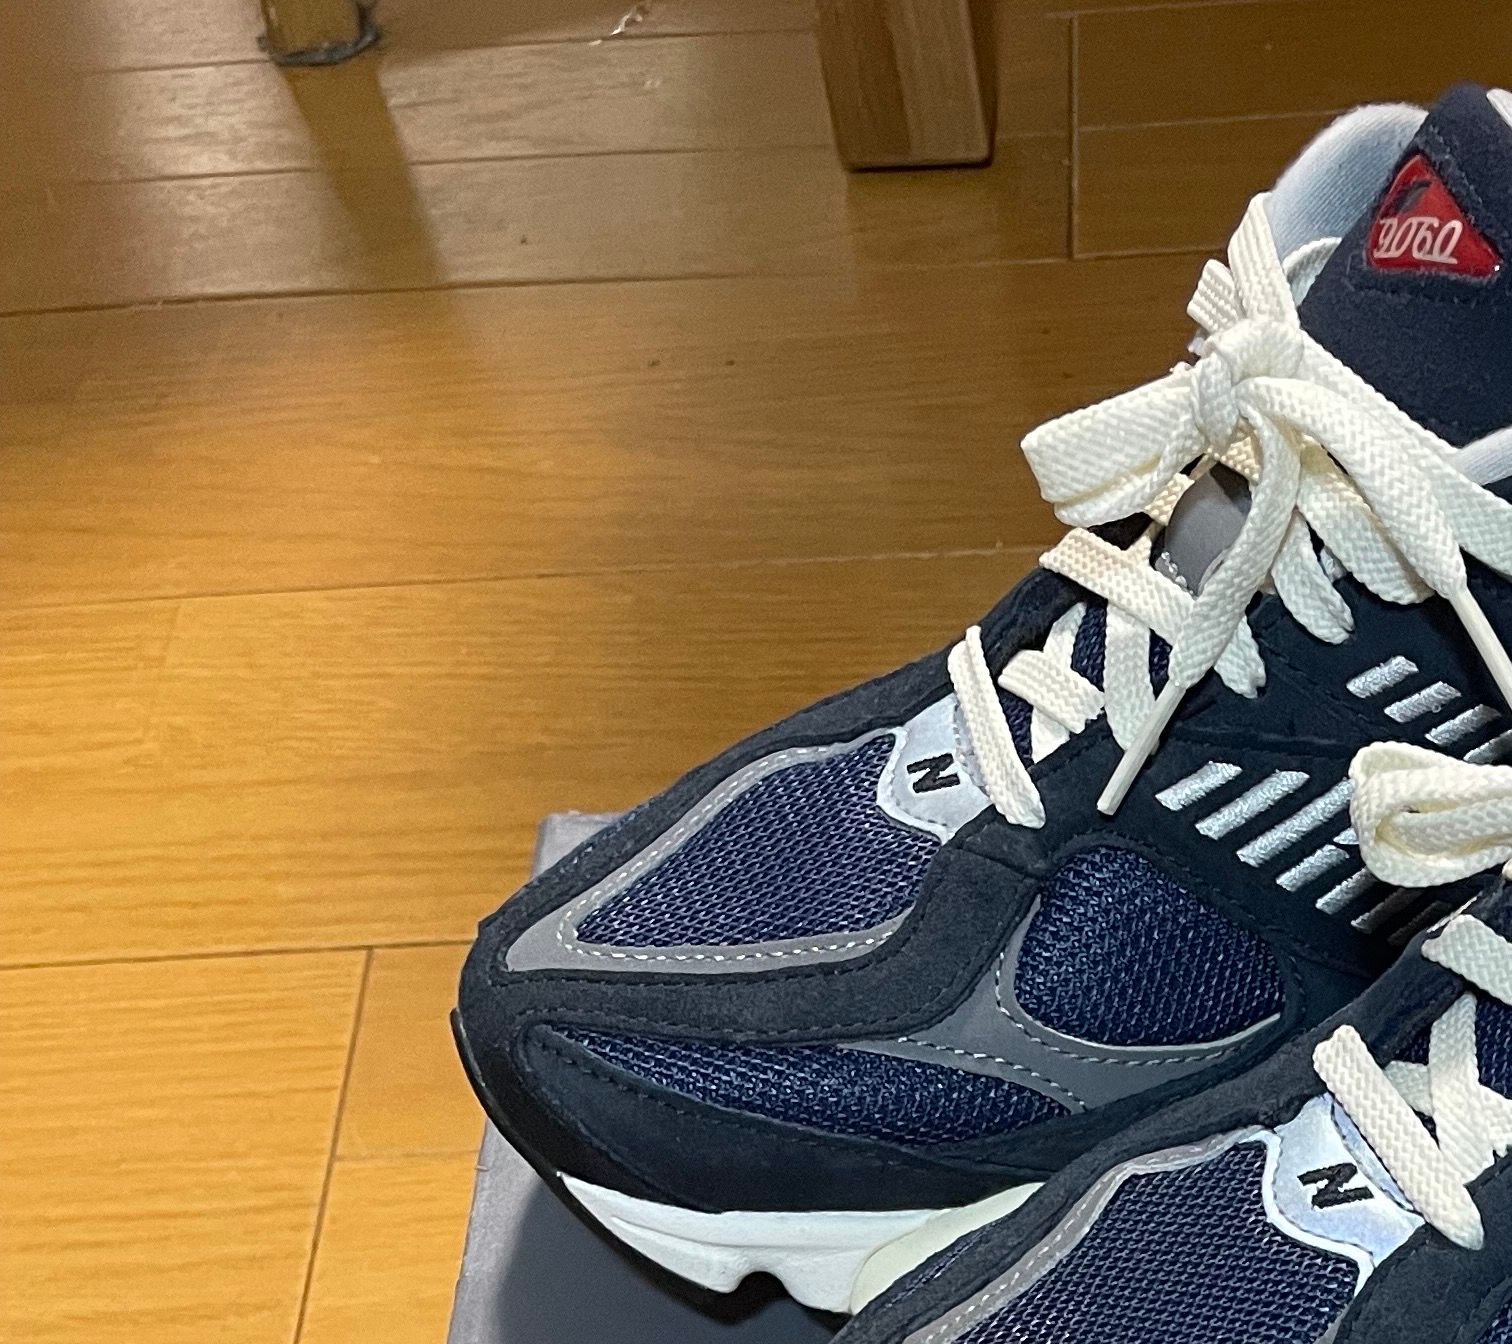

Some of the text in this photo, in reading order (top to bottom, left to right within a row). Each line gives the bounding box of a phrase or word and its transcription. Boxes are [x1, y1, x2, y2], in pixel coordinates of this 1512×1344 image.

[1373, 216, 1463, 264] 9060
[906, 753, 961, 795] N
[1298, 1161, 1376, 1211] N
